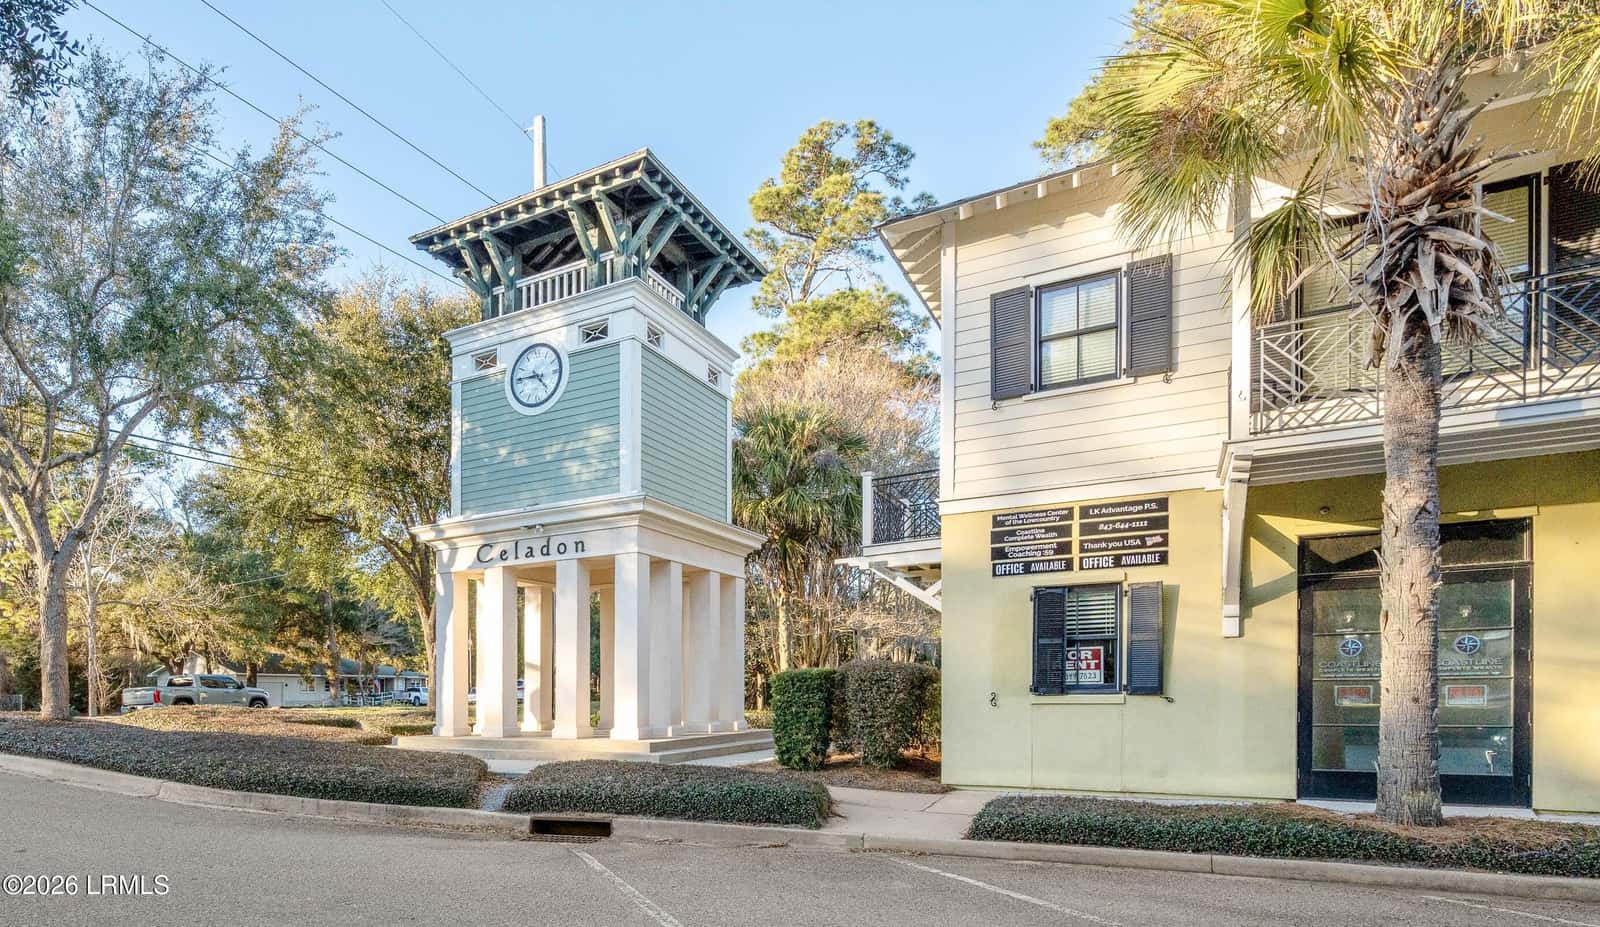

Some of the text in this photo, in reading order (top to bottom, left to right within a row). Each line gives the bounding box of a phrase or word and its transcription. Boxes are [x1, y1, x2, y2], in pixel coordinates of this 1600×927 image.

[1089, 508, 1100, 516] LK
[1101, 505, 1143, 514] Advantage
[1023, 515, 1060, 524] Lowcountry
[1004, 534, 1034, 542] Complete
[1005, 543, 1057, 552] Empowerment
[1083, 538, 1141, 550] Thank you USA
[477, 536, 586, 563] Celadon
[1008, 550, 1041, 558] Coaching
[1083, 553, 1160, 569] OFFICE AVAILABLE
[996, 560, 1066, 575] OFFICE AVAILABLE
[1067, 651, 1092, 660] OR
[1066, 660, 1099, 669] ENT
